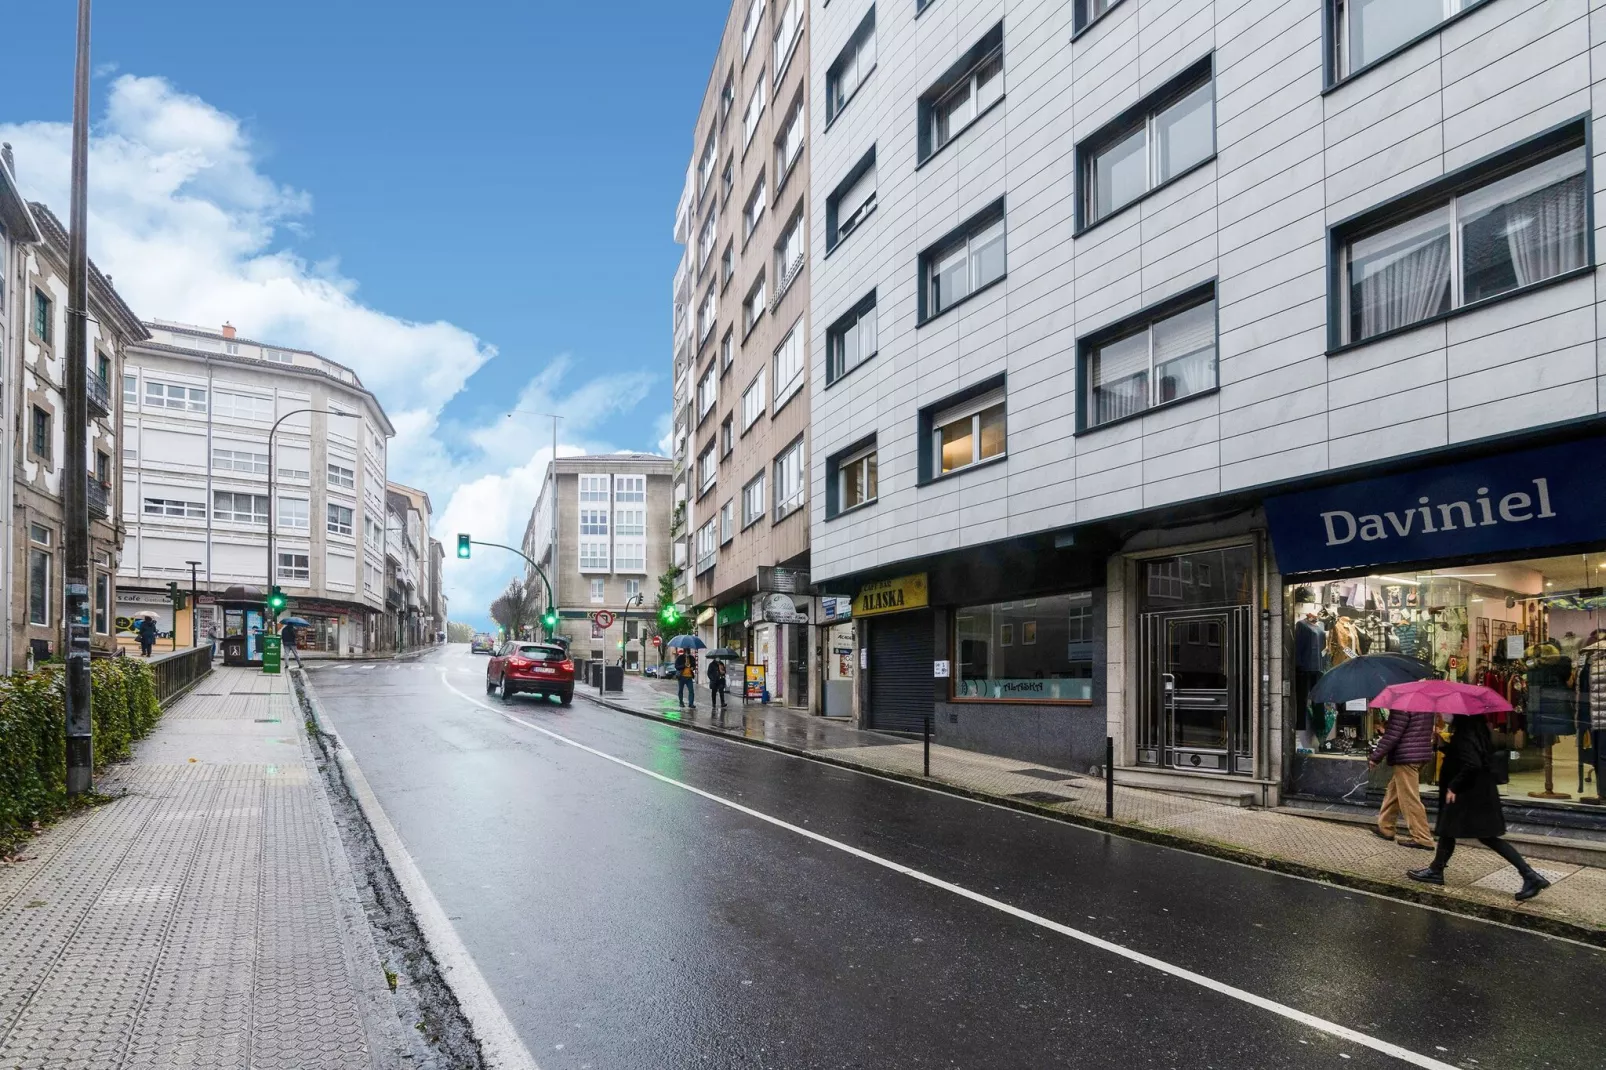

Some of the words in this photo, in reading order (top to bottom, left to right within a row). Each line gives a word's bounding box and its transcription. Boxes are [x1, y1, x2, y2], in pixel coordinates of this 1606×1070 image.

[1320, 477, 1556, 546] Daviniel
[862, 588, 905, 611] ALASKA
[1003, 682, 1044, 692] ALASKA
